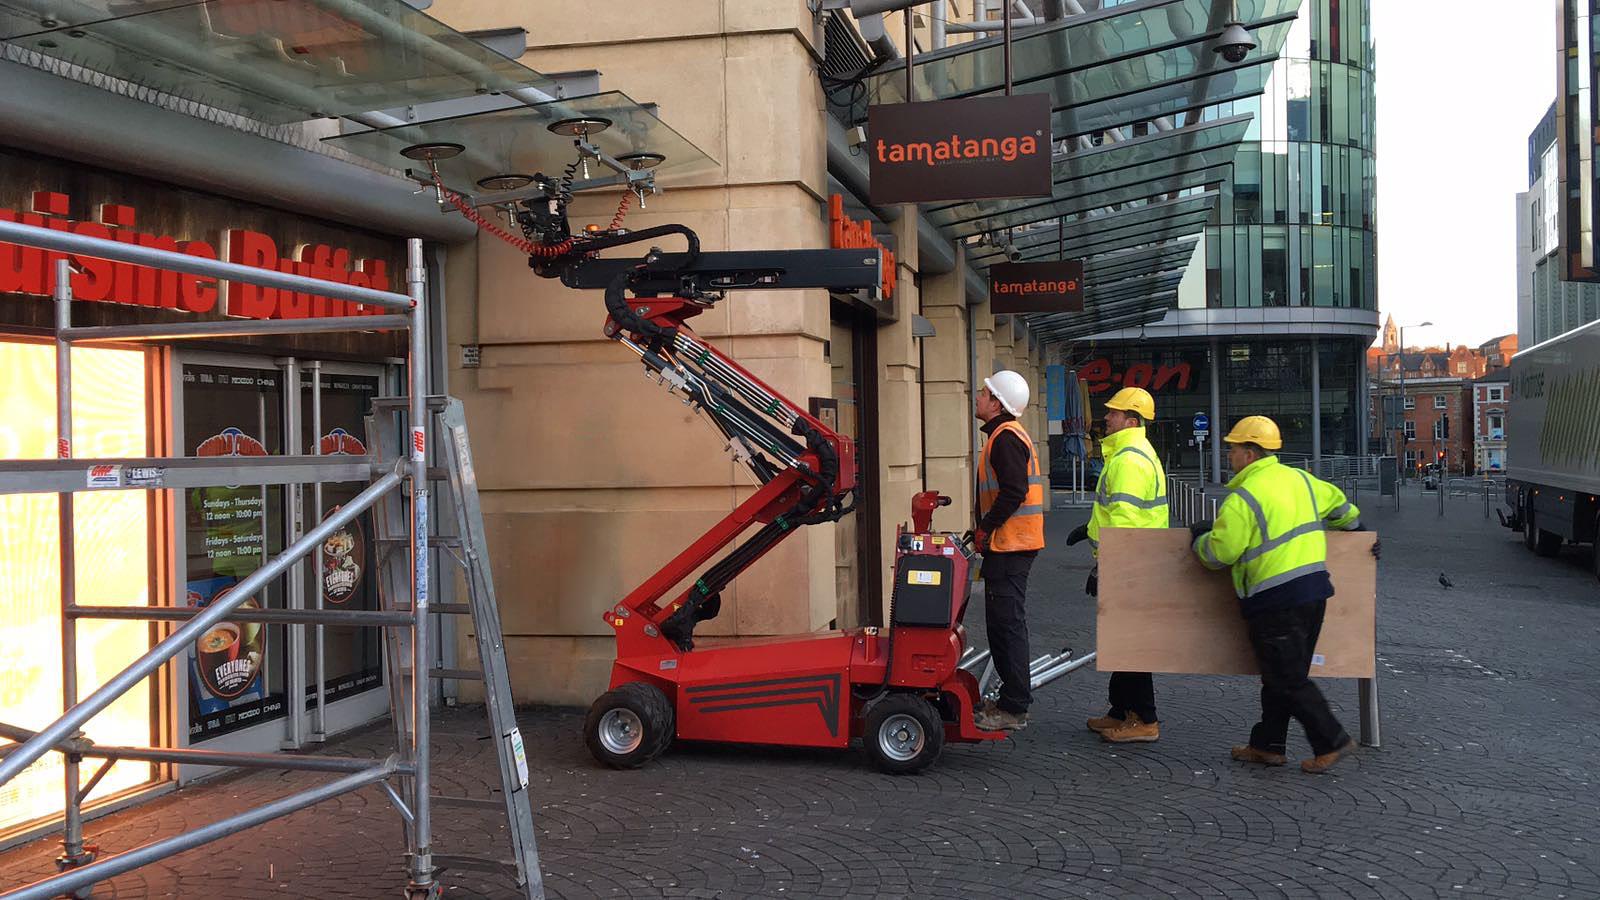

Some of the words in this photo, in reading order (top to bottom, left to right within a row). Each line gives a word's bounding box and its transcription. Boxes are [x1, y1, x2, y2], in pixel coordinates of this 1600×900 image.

[876, 134, 1037, 166] tamatanga
[994, 280, 1076, 295] tamatanga
[132, 467, 157, 479] LEWIS
[203, 499, 230, 509] Sundays
[206, 512, 213, 520] 12
[236, 509, 252, 518] 10:00
[252, 510, 263, 519] pm
[205, 537, 229, 547] Fridays
[233, 533, 264, 544] Saturdays
[207, 550, 214, 558] 12
[252, 547, 263, 555] pm
